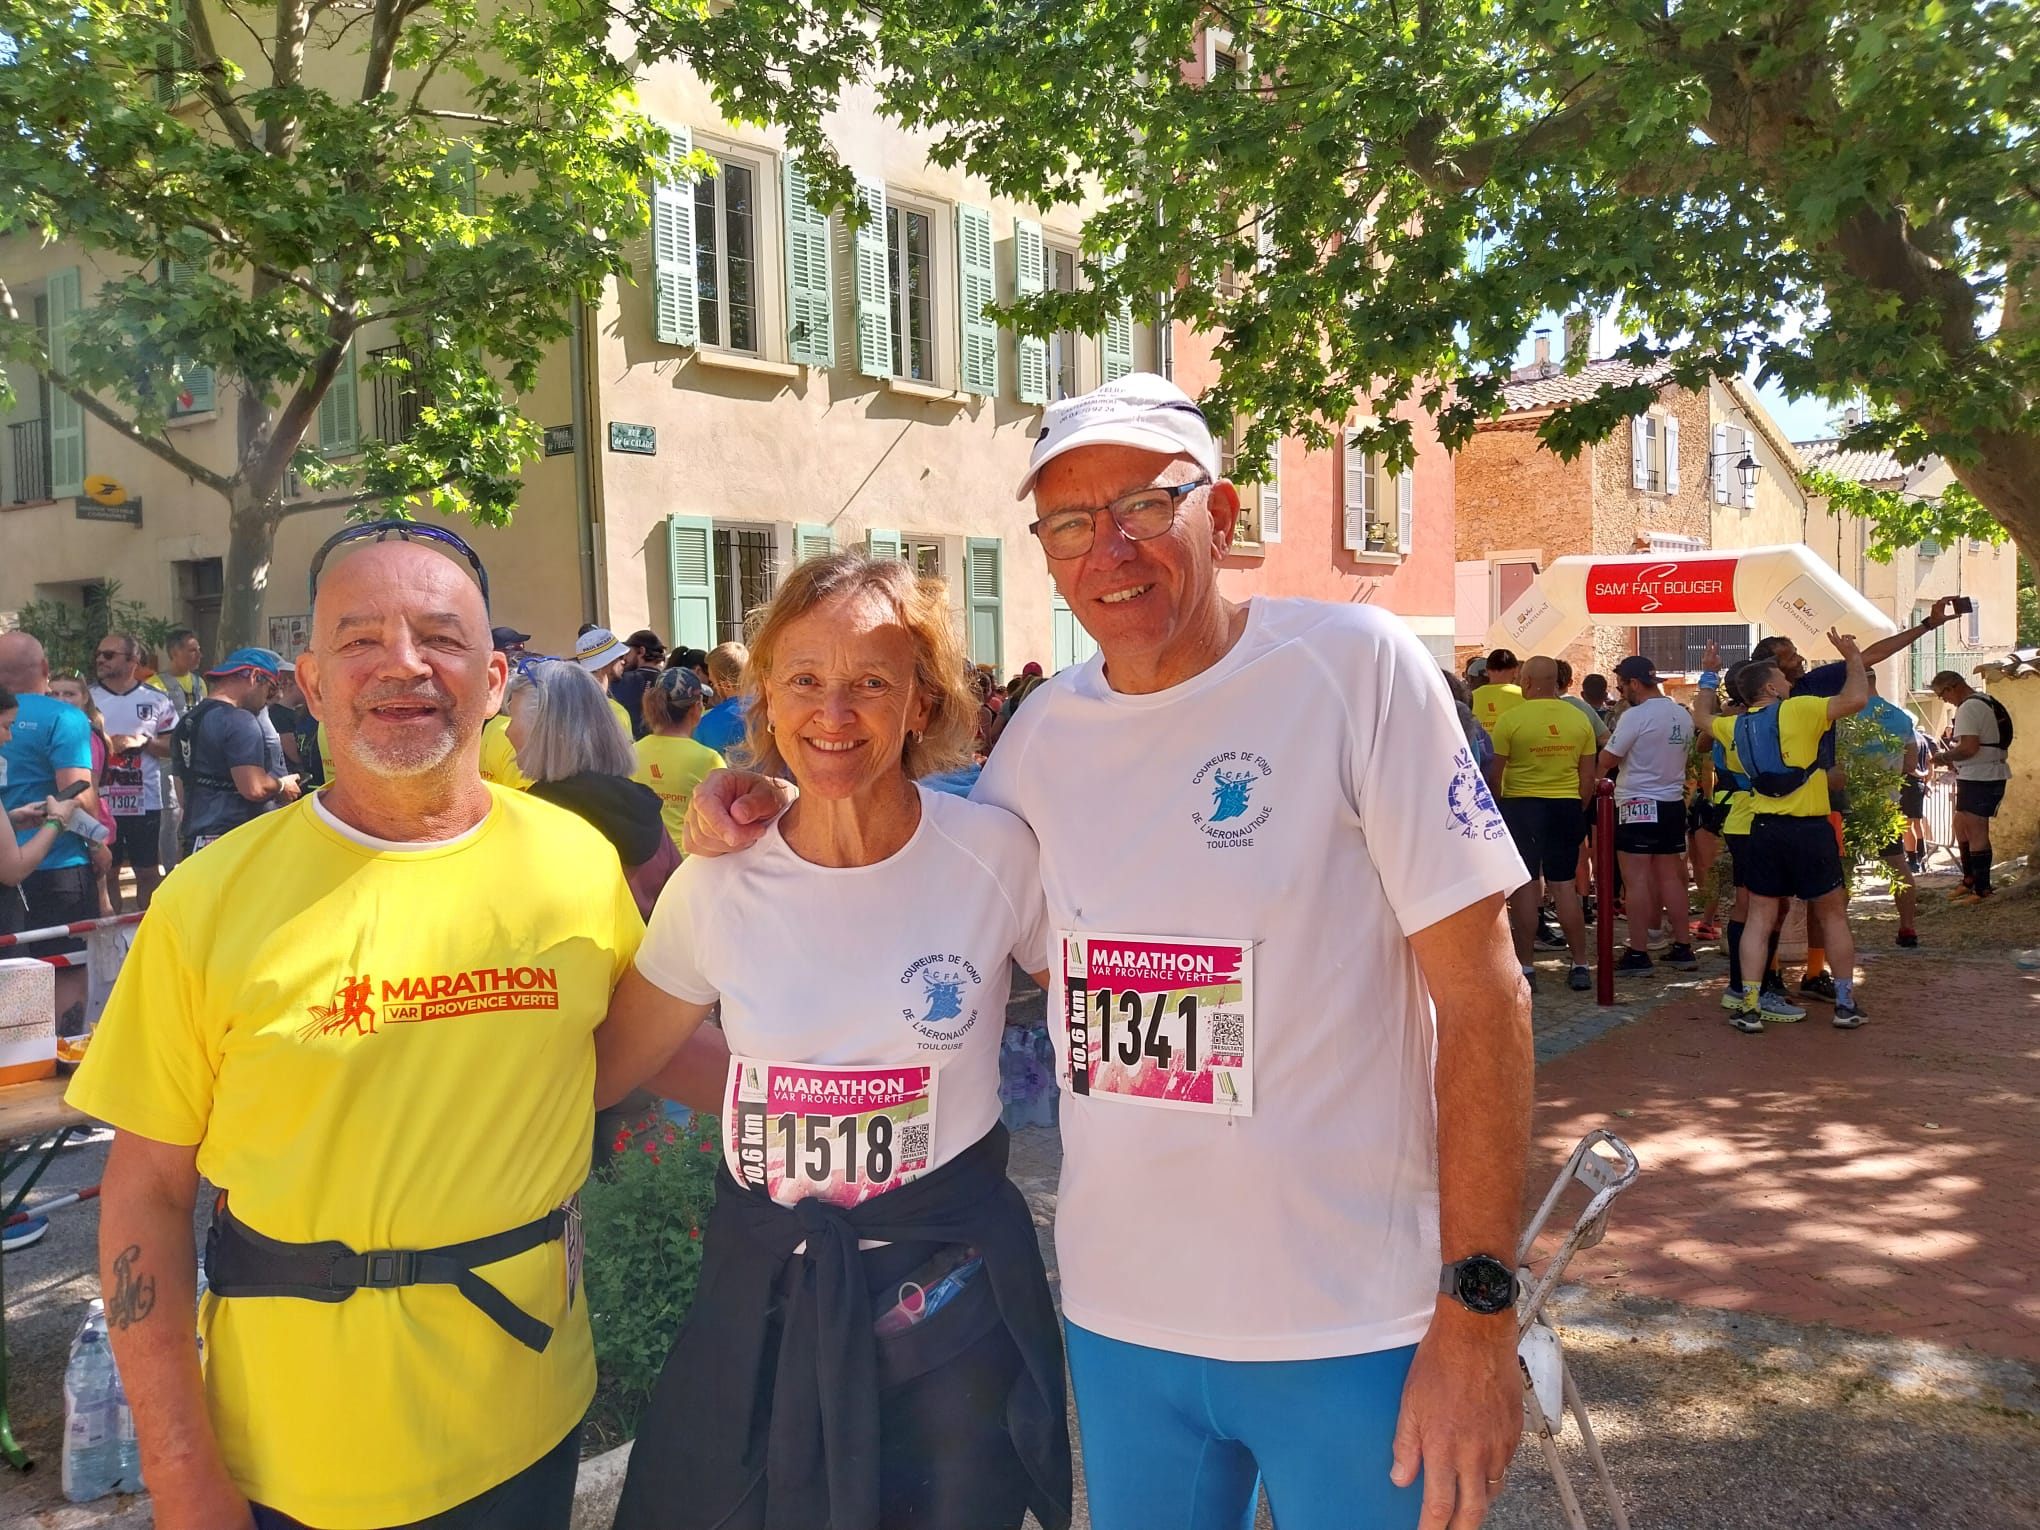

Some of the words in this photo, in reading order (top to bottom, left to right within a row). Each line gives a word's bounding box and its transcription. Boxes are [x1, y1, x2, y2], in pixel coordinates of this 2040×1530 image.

[1595, 582, 1628, 596] SAM'
[1632, 582, 1661, 595] FAIT
[1664, 580, 1722, 594] BOUGER
[1192, 751, 1237, 784] COUREURS
[1241, 752, 1254, 762] DE
[1254, 756, 1273, 777] FOND
[112, 795, 137, 809] 1302
[1626, 804, 1649, 816] 1418
[1191, 812, 1203, 825] DE
[1200, 806, 1273, 839] L'AERONAUTIQUE
[1461, 826, 1478, 840] Air
[1206, 838, 1254, 849] TOULOUSE
[900, 953, 944, 984] COUREURS
[948, 954, 962, 965] DE
[962, 961, 982, 985] FOND
[1091, 949, 1214, 973] MARATHON
[1092, 966, 1111, 976] VAR
[1115, 967, 1173, 981] PROVENCE
[1178, 972, 1214, 983] VERTE
[382, 967, 558, 1002] MARATHON
[389, 1007, 418, 1019] VAR
[426, 996, 507, 1017] PROVENCE
[511, 994, 556, 1007] VERTE
[1070, 990, 1085, 1025] km
[902, 1008, 915, 1021] DE
[912, 1009, 978, 1041] L'AERONAUTIQUE
[1095, 989, 1198, 1072] 1341
[916, 1042, 964, 1051] TOULOUSE
[1071, 1028, 1087, 1072] 10,6
[773, 1075, 905, 1096] MARATHON
[774, 1091, 796, 1101] VAR
[801, 1094, 864, 1105] PROVENCE
[869, 1093, 904, 1104] VERTE
[741, 1113, 764, 1146] km
[777, 1111, 893, 1184] 1518
[742, 1148, 766, 1185] 10,6
